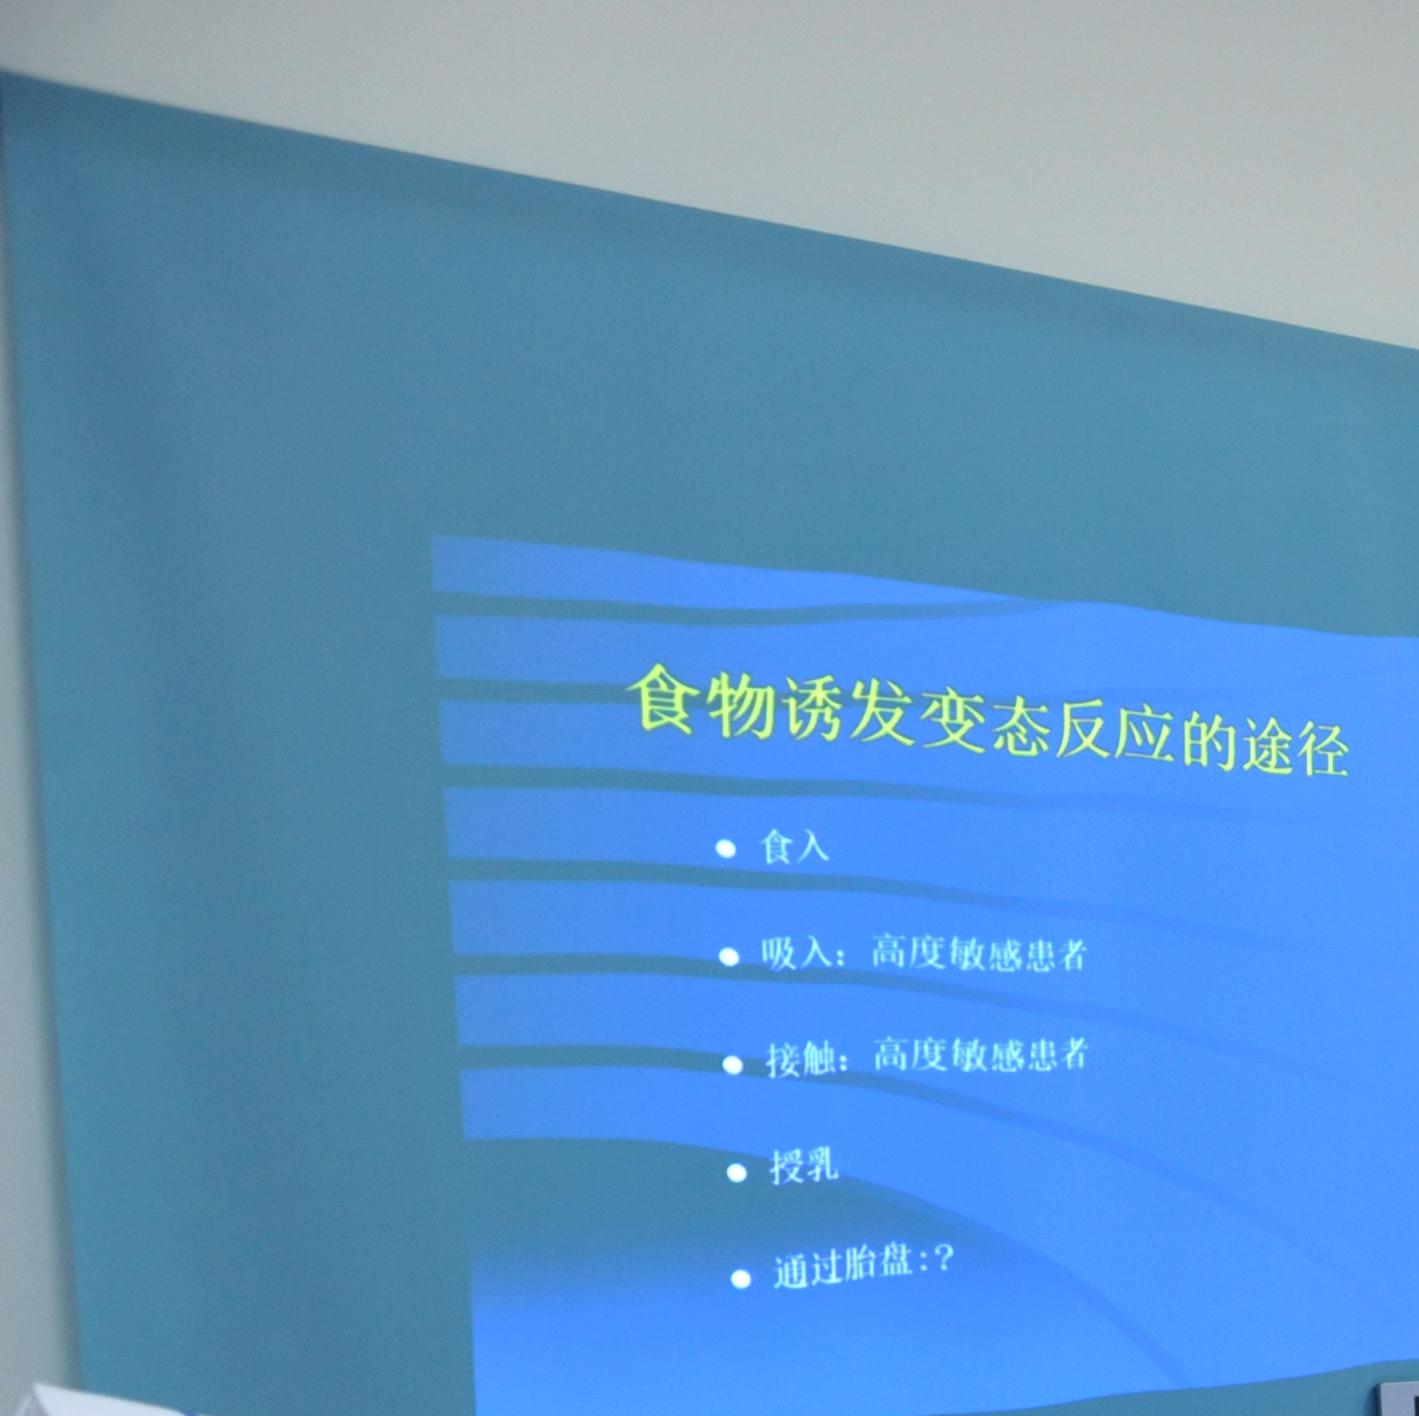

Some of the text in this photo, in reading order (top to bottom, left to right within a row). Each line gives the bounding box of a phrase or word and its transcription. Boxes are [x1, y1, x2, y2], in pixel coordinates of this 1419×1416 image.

[626, 662, 1350, 778] 食物诱发变态反应的途径
[759, 827, 830, 865] 食入
[768, 1145, 841, 1186] 授乳
